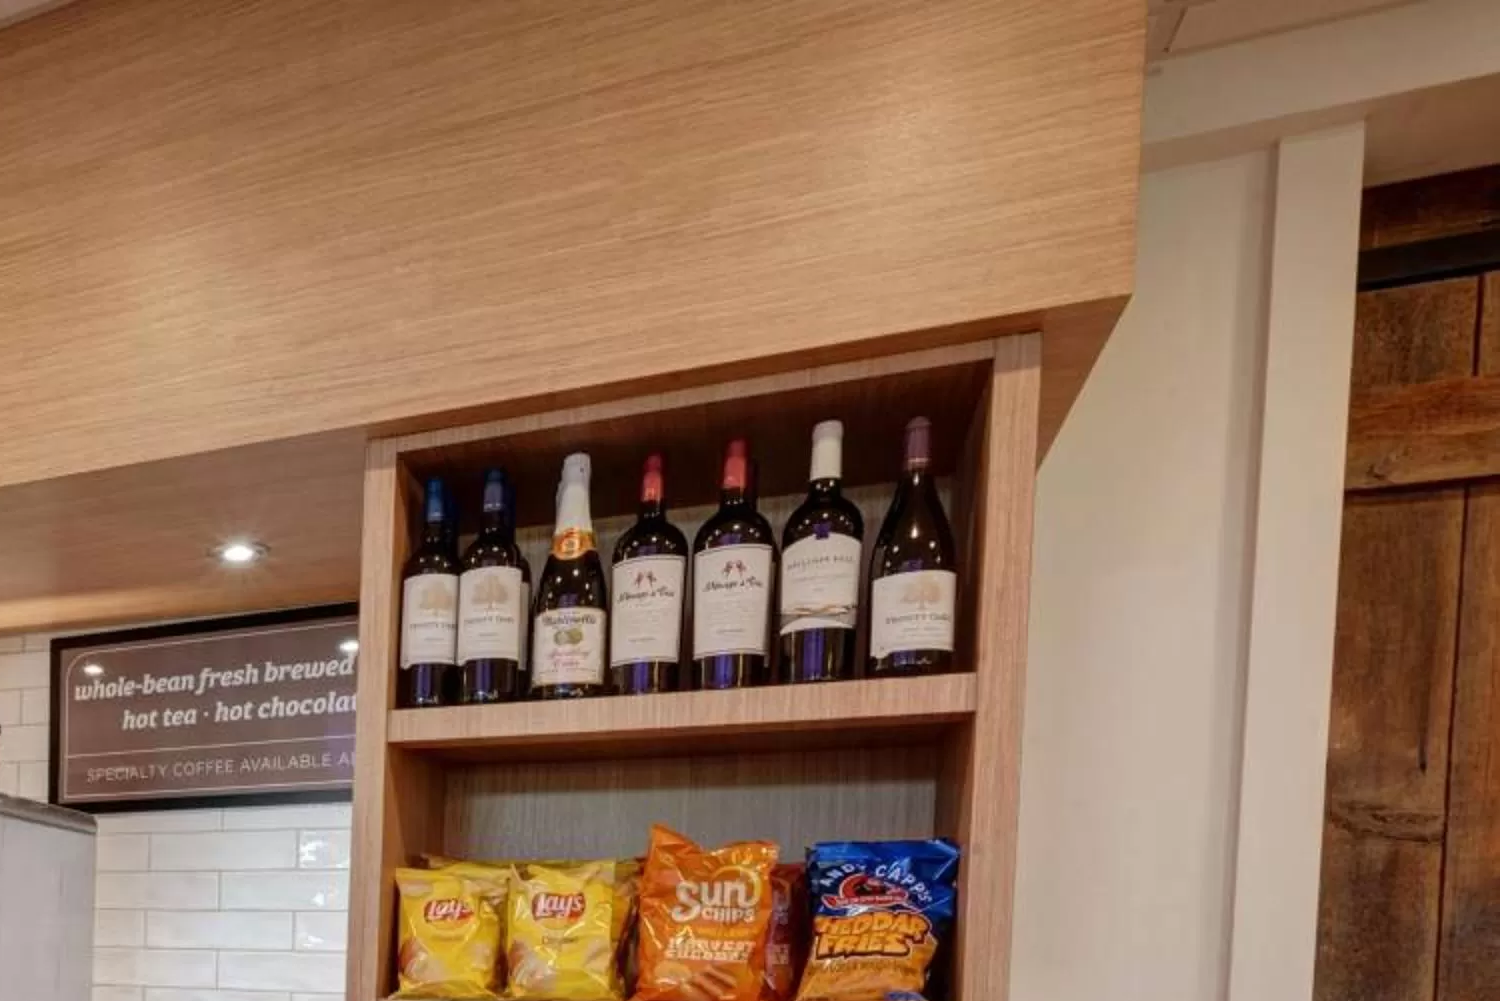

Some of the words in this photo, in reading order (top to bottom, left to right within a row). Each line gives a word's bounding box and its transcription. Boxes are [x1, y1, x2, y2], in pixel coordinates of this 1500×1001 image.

[74, 673, 194, 701] whole-bean
[195, 664, 260, 696] fresh
[264, 652, 356, 684] brewed
[122, 709, 157, 731] hot
[163, 707, 197, 728] tea
[214, 701, 253, 723] hot
[86, 764, 168, 783] SPECIALTY
[173, 759, 234, 779] COFFEE
[239, 752, 334, 773] AVAILABLE
[819, 863, 868, 888] ANDY
[671, 879, 756, 922] Sun
[701, 907, 756, 924] CHIPS
[817, 934, 911, 959] FRIES
